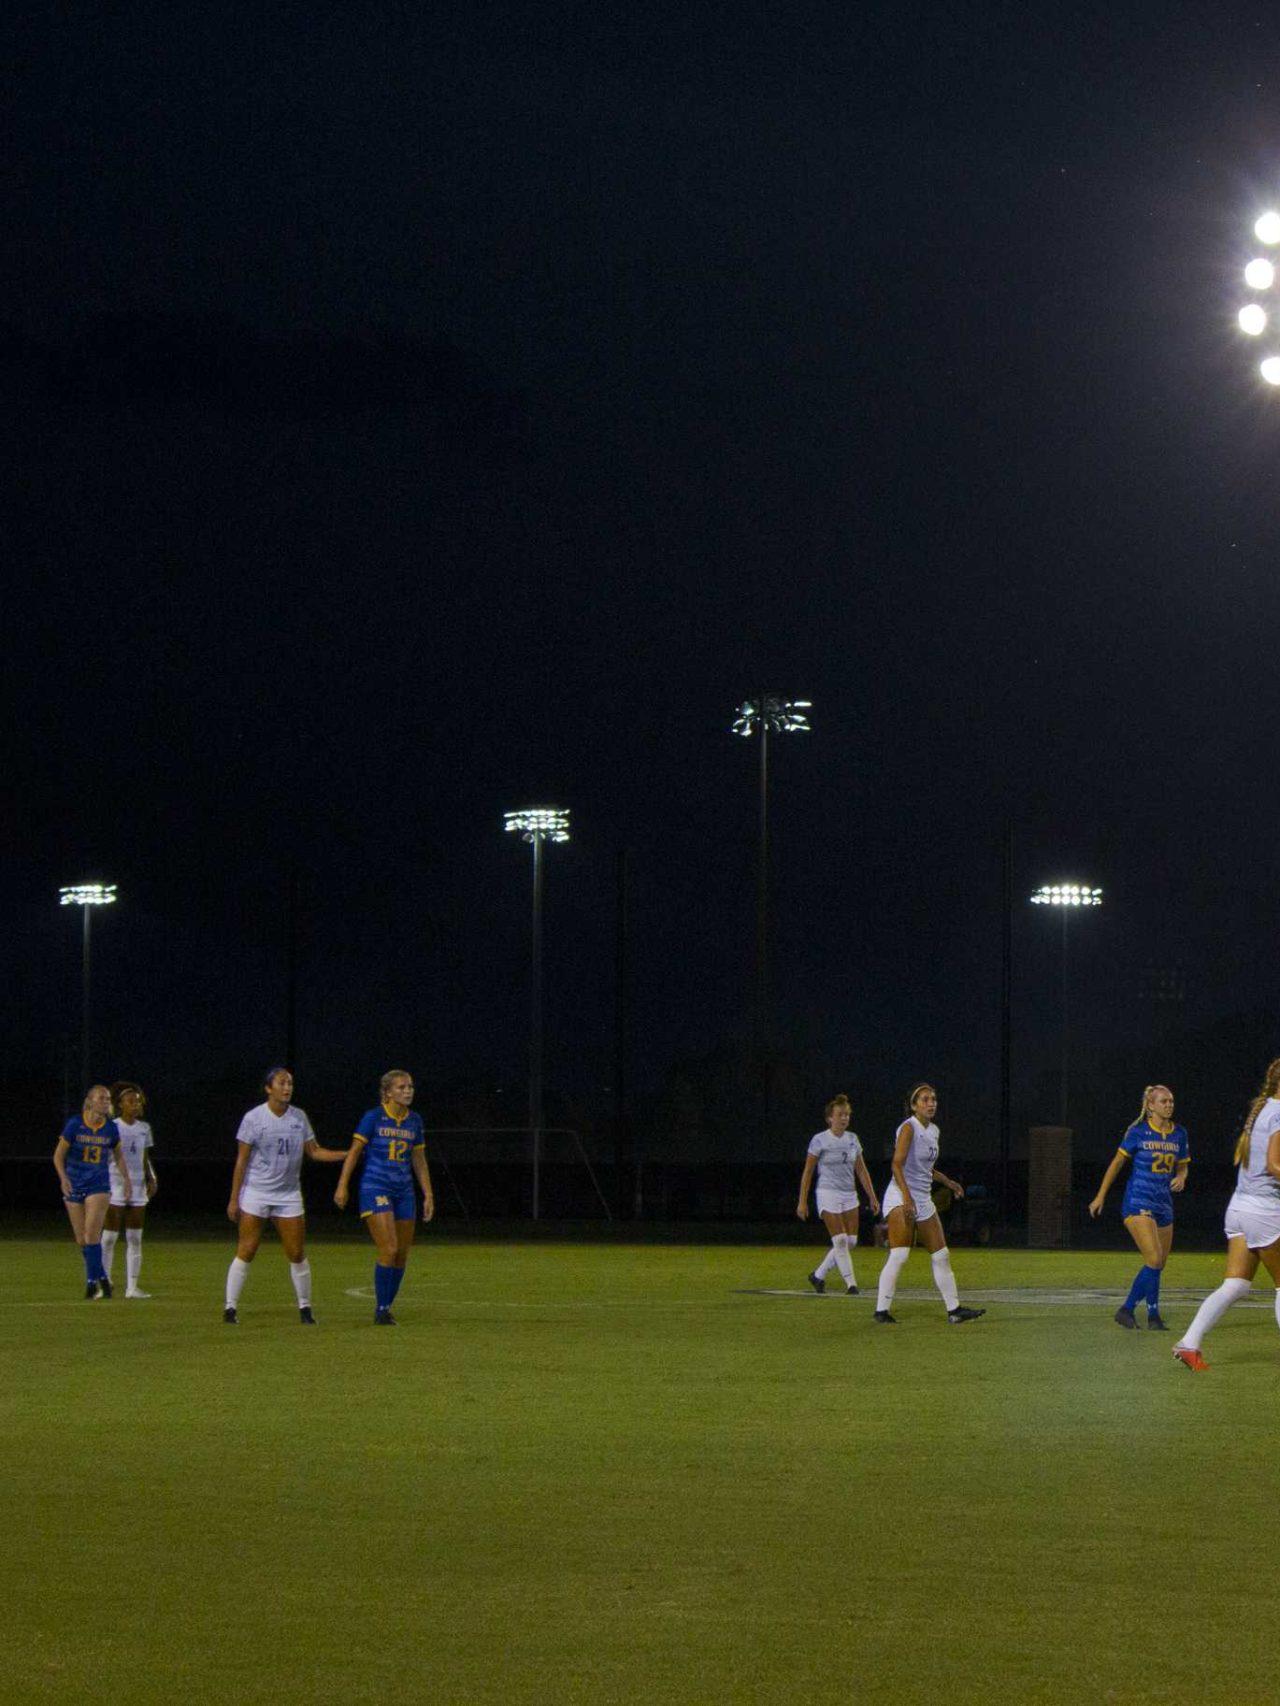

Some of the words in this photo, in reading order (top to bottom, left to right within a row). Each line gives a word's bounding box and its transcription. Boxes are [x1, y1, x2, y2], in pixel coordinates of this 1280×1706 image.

[82, 1145, 103, 1164] 13
[129, 1141, 137, 1154] 4
[278, 1138, 290, 1156] 21
[388, 1140, 408, 1162] 12
[842, 1152, 848, 1164] 2
[1151, 1152, 1175, 1174] 29
